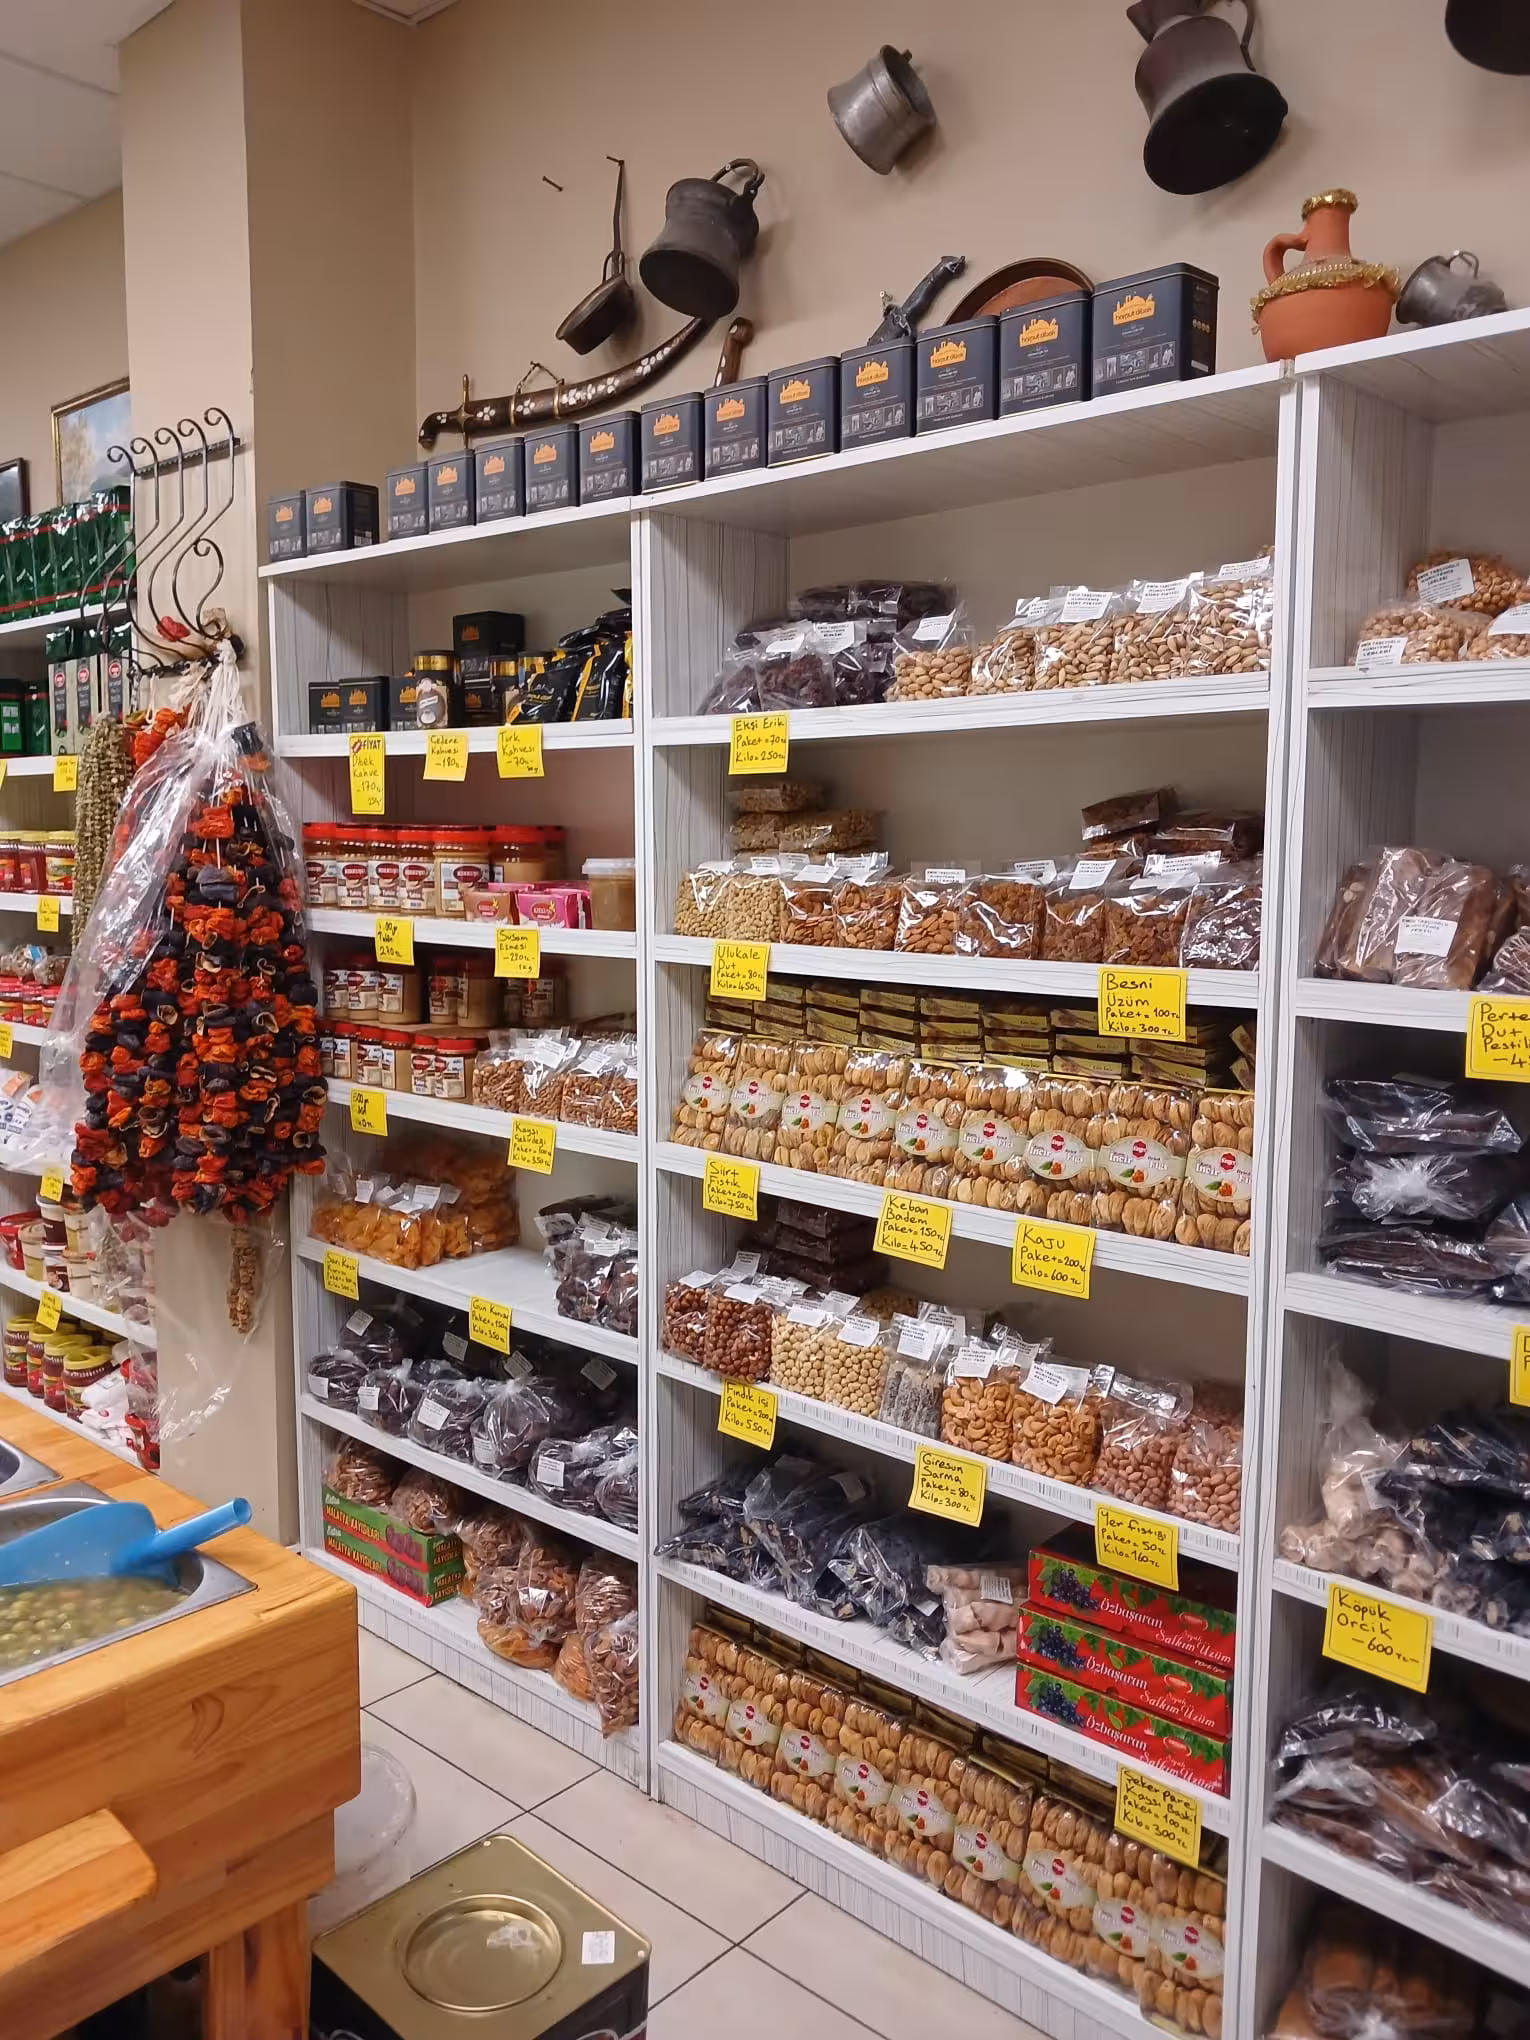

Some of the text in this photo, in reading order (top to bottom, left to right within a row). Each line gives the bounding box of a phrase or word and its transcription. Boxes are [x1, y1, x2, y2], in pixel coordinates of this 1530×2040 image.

[763, 717, 785, 729] Erik
[718, 945, 761, 960] Ulukale
[718, 958, 736, 970] Dut
[1106, 973, 1153, 990] Besni
[1481, 1022, 1523, 1038] Dut
[889, 1195, 929, 1215] Keban
[886, 1207, 928, 1225] Badem
[922, 1452, 964, 1473] Giresun
[921, 1465, 962, 1485] Sarma
[1100, 1510, 1124, 1527] Yer
[1100, 1597, 1162, 1629] Özbaşaran
[1336, 1612, 1393, 1641] Orcik
[1155, 1629, 1231, 1664] Salkım Üzüm
[1086, 1655, 1148, 1690] Özbaşaran
[1140, 1690, 1215, 1728] Salkım Üzüm
[1086, 1714, 1148, 1751] Özbaşaran
[1162, 1790, 1195, 1811] Pare
